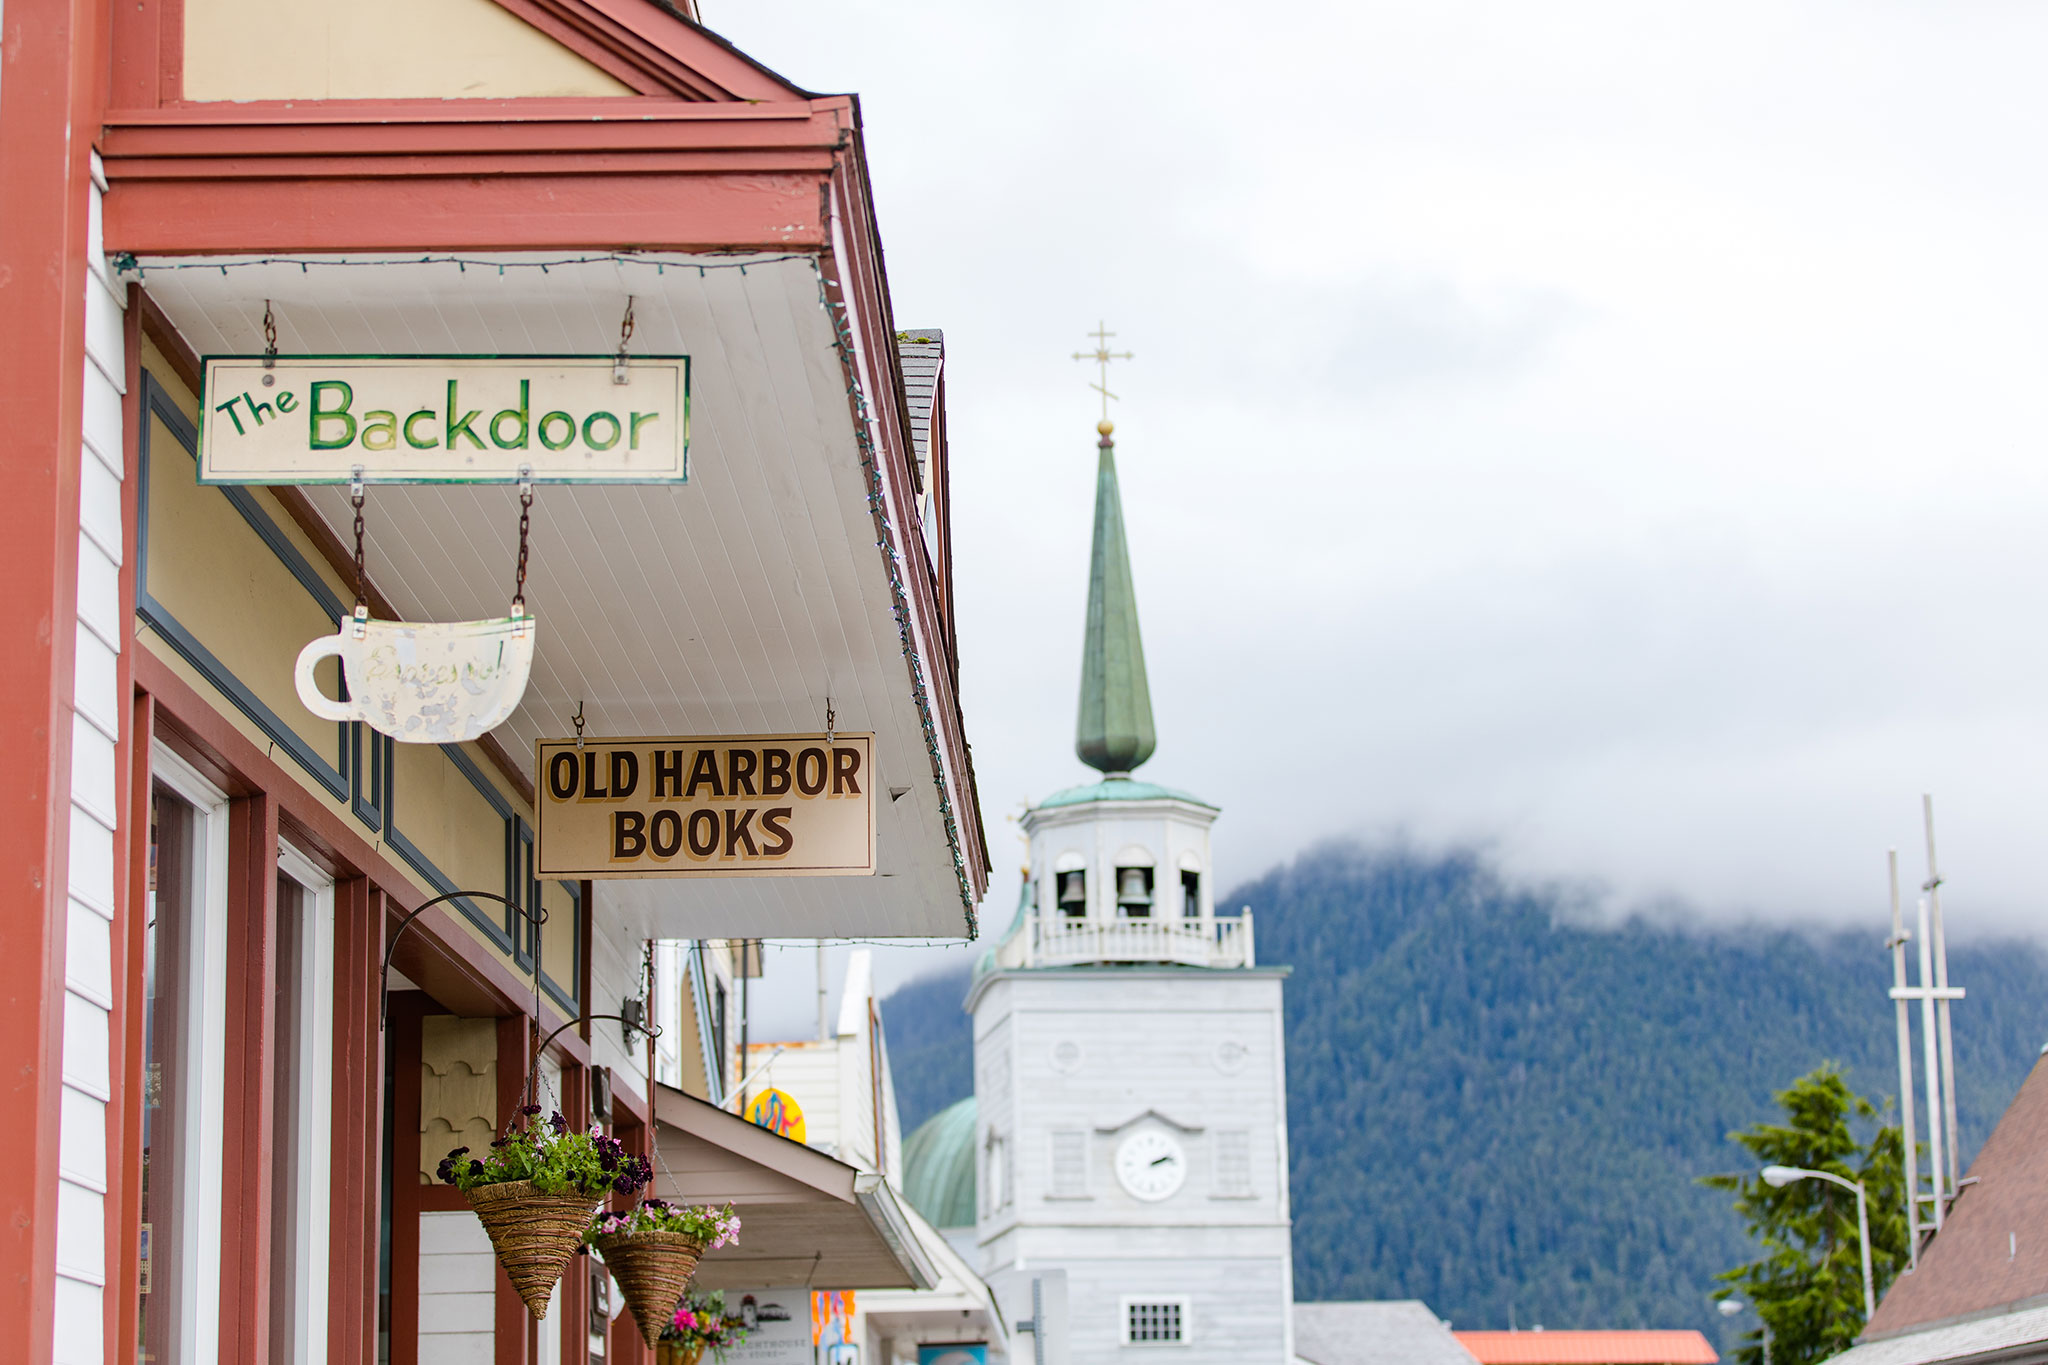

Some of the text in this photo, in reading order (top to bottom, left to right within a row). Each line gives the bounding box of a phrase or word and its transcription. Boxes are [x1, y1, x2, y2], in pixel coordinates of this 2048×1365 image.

[215, 379, 660, 451] The Backdoor
[547, 746, 864, 801] OLD HARBOR
[610, 806, 795, 863] BOOKS
